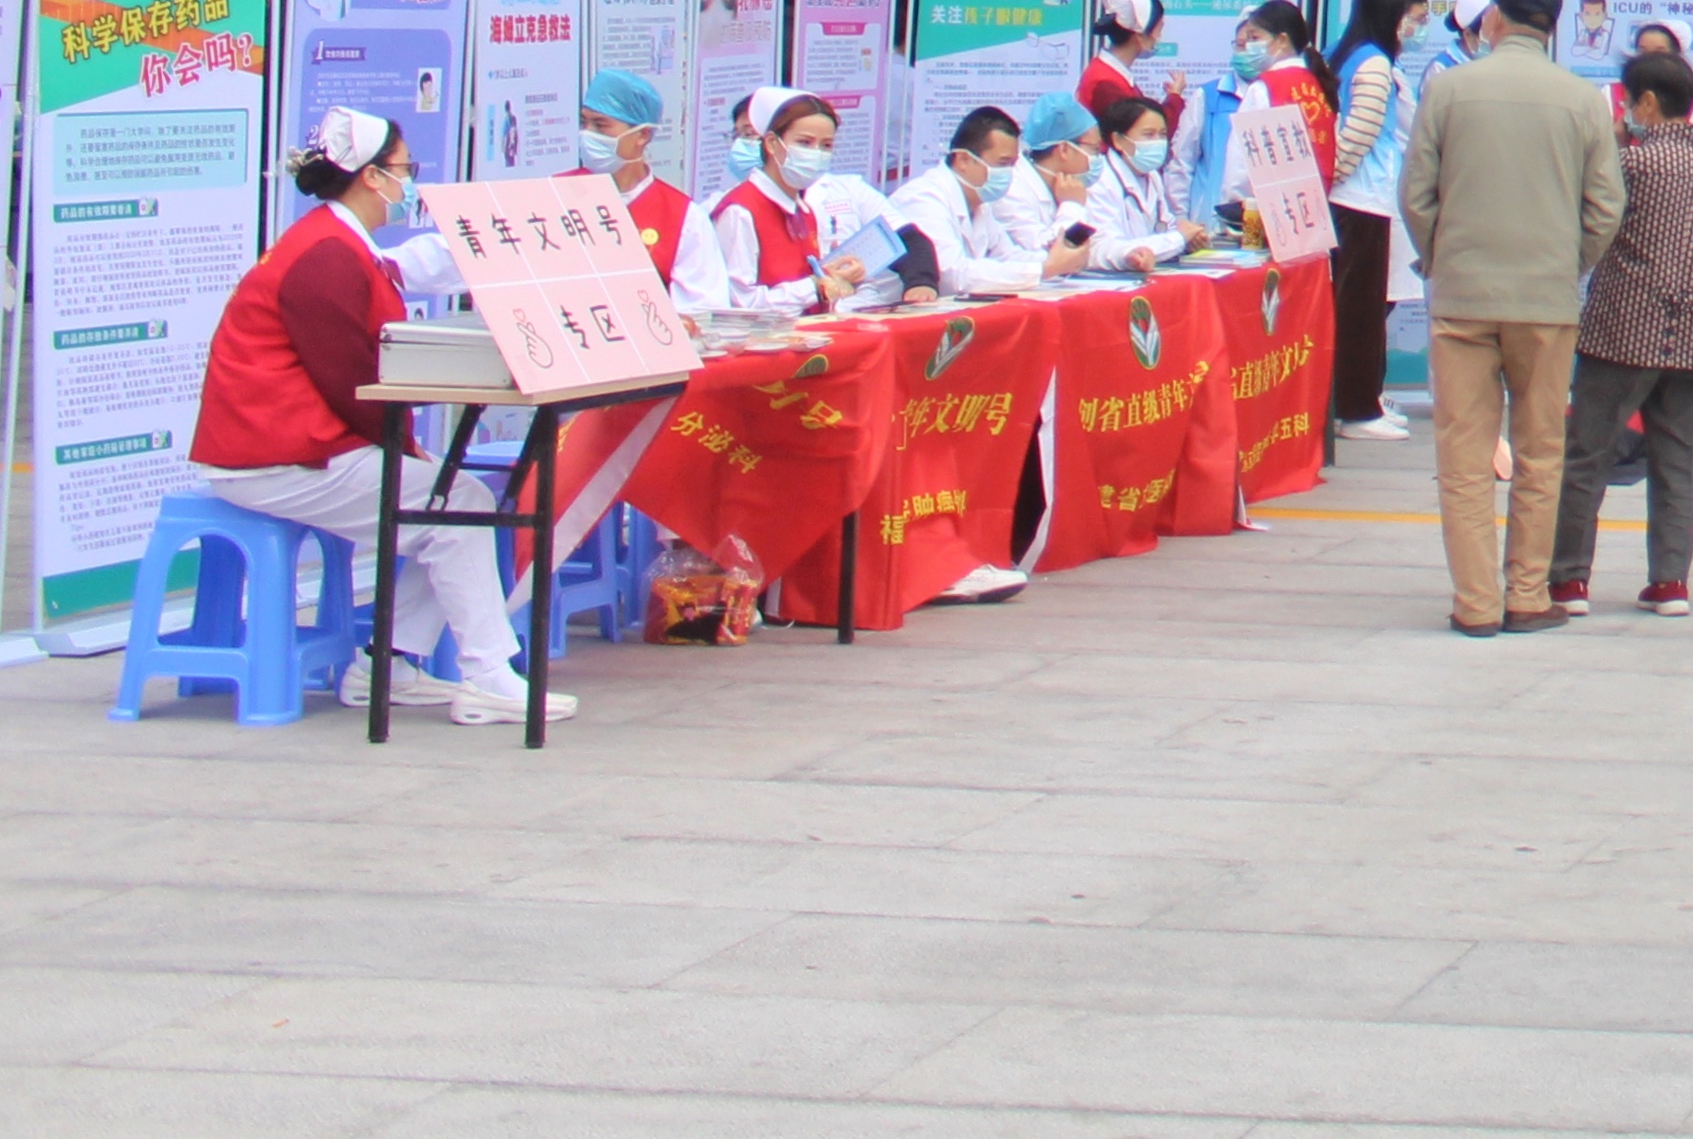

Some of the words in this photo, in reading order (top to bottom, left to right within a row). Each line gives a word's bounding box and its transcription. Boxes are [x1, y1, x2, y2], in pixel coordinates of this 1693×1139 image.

[455, 205, 622, 259] 青年文明号
[559, 304, 626, 350] 专区
